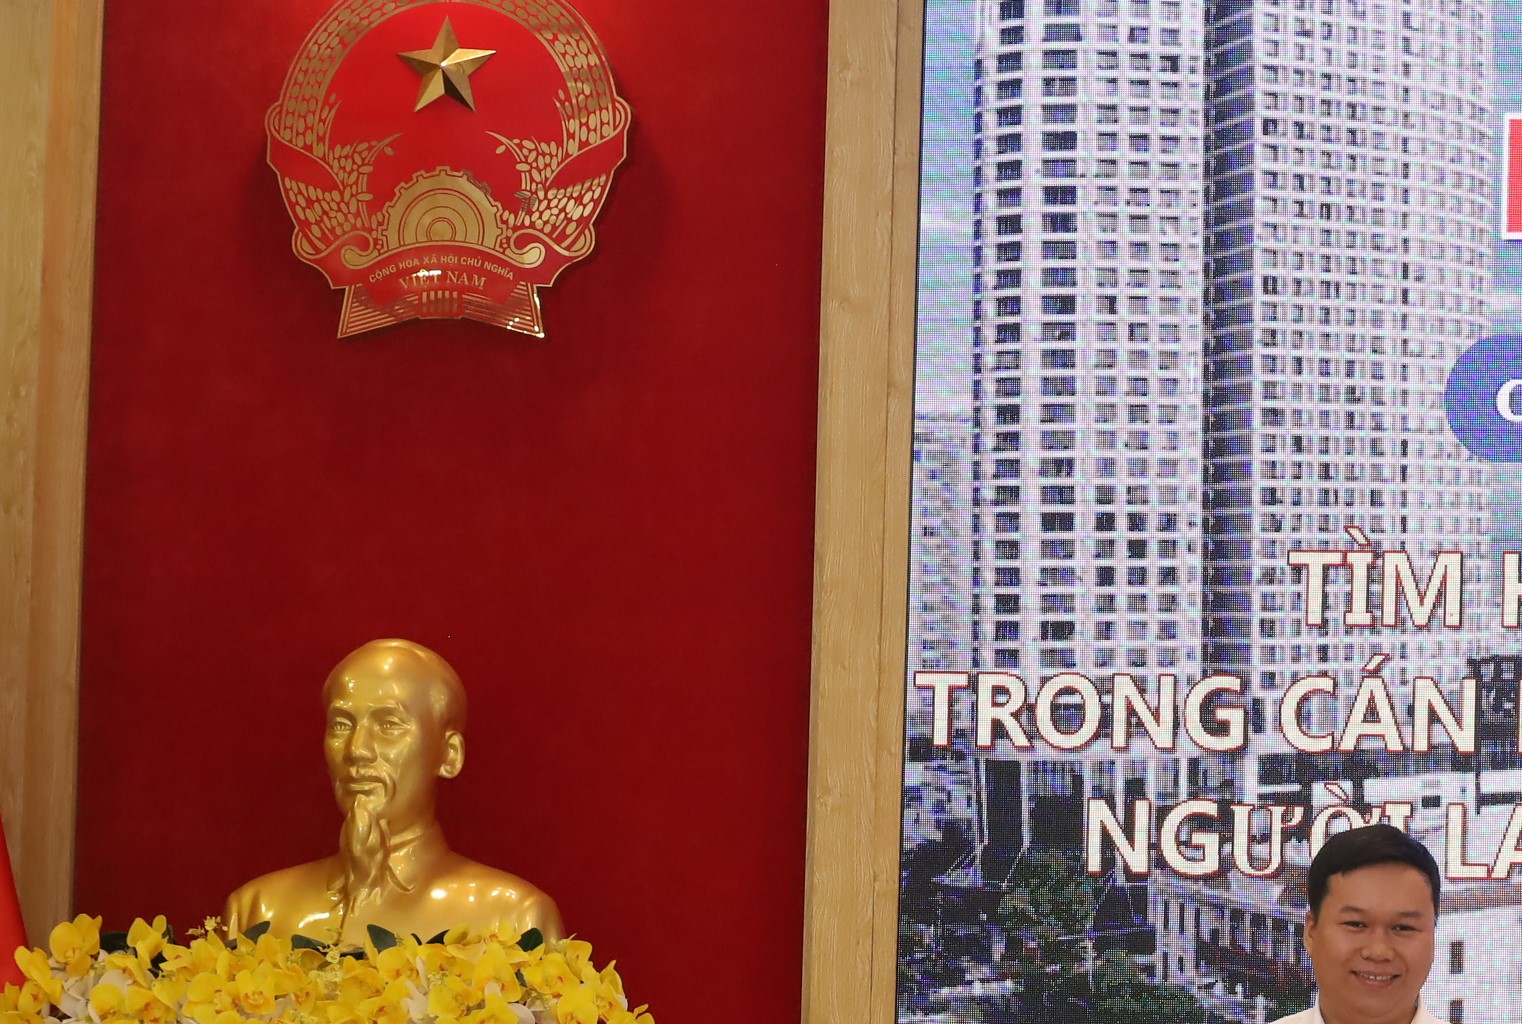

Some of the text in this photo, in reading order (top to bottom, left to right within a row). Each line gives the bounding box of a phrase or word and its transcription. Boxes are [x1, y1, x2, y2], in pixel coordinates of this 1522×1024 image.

[446, 270, 487, 290] NAM
[1287, 525, 1464, 629] TÌM
[914, 671, 1250, 753] TRONG
[1279, 653, 1480, 755] CÁN
